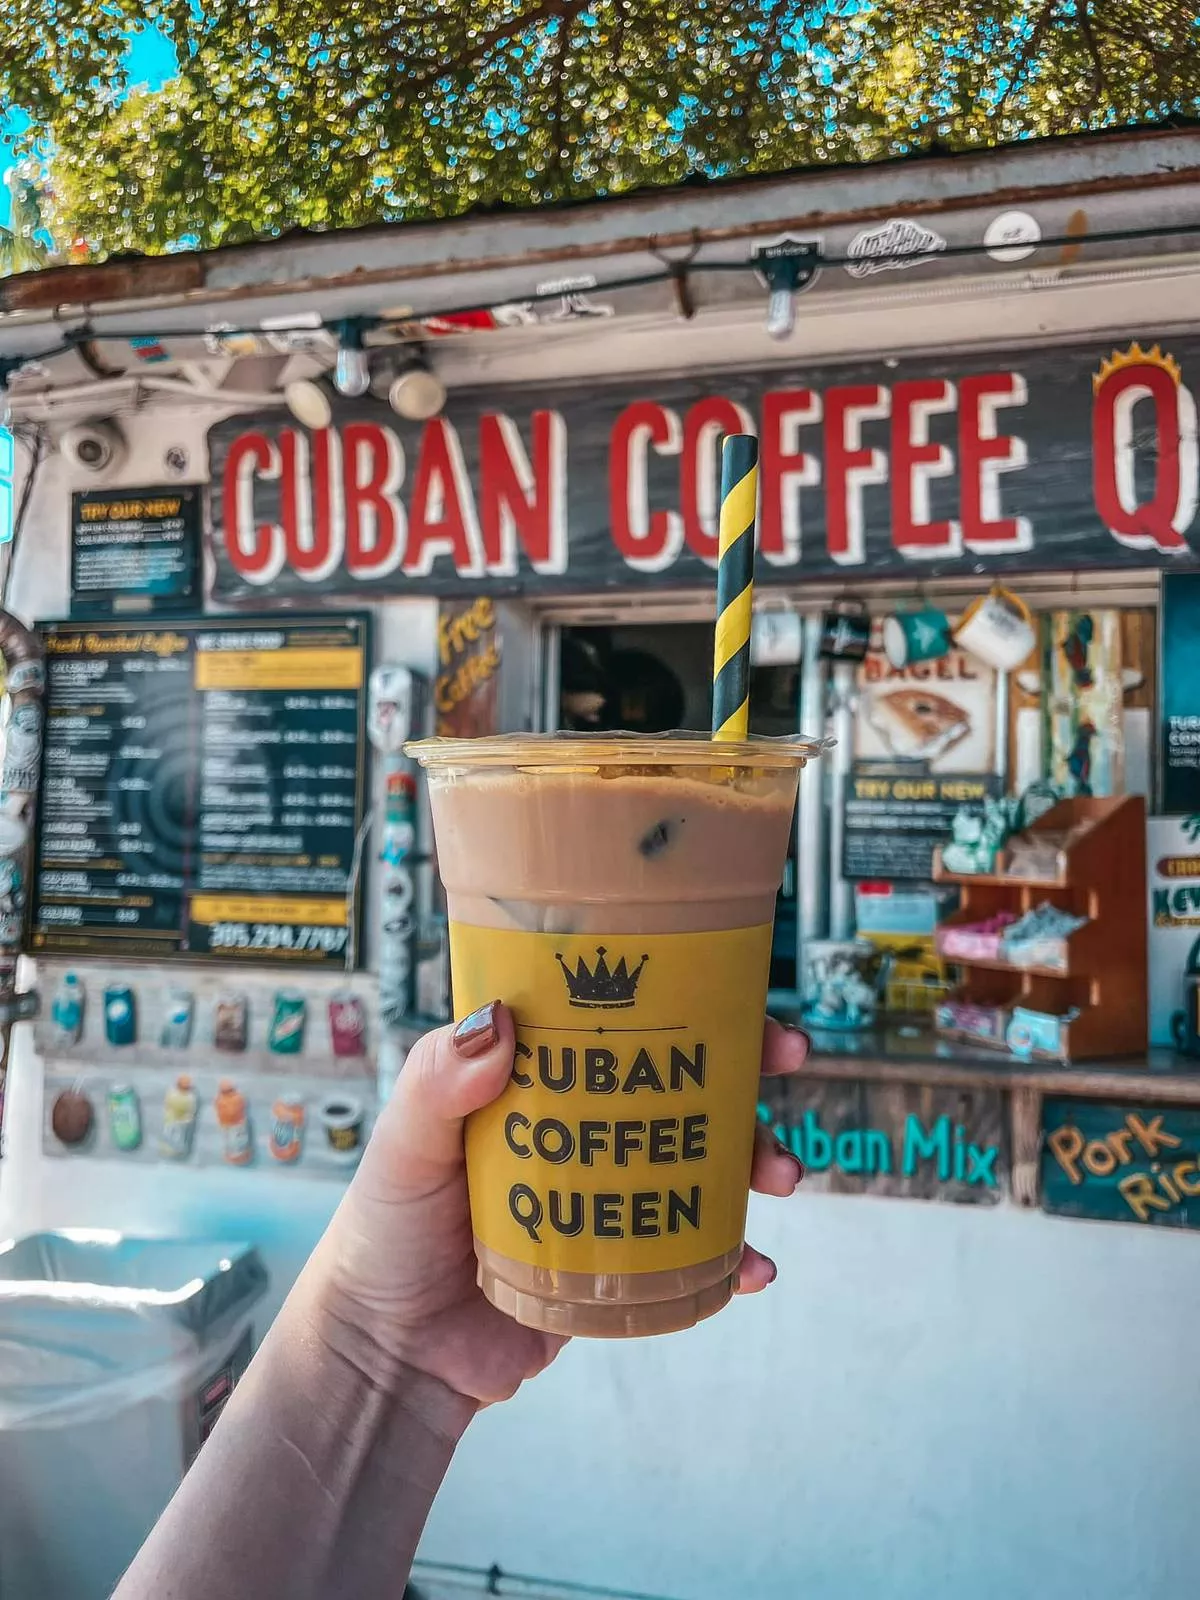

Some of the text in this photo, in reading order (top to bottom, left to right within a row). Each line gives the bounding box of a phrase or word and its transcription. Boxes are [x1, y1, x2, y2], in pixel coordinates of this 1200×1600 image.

[223, 408, 568, 585] CUBAN
[609, 370, 1033, 573] COFFEE
[864, 655, 978, 683] BGEL
[855, 780, 986, 800] TRY OUR NEW
[510, 1041, 707, 1095] CUBAN
[504, 1112, 709, 1167] COFFEE
[757, 1102, 999, 1188] uban Mix
[1048, 1113, 1182, 1185] Pork
[508, 1183, 703, 1243] QUEEN
[1118, 1160, 1200, 1222] Ric
